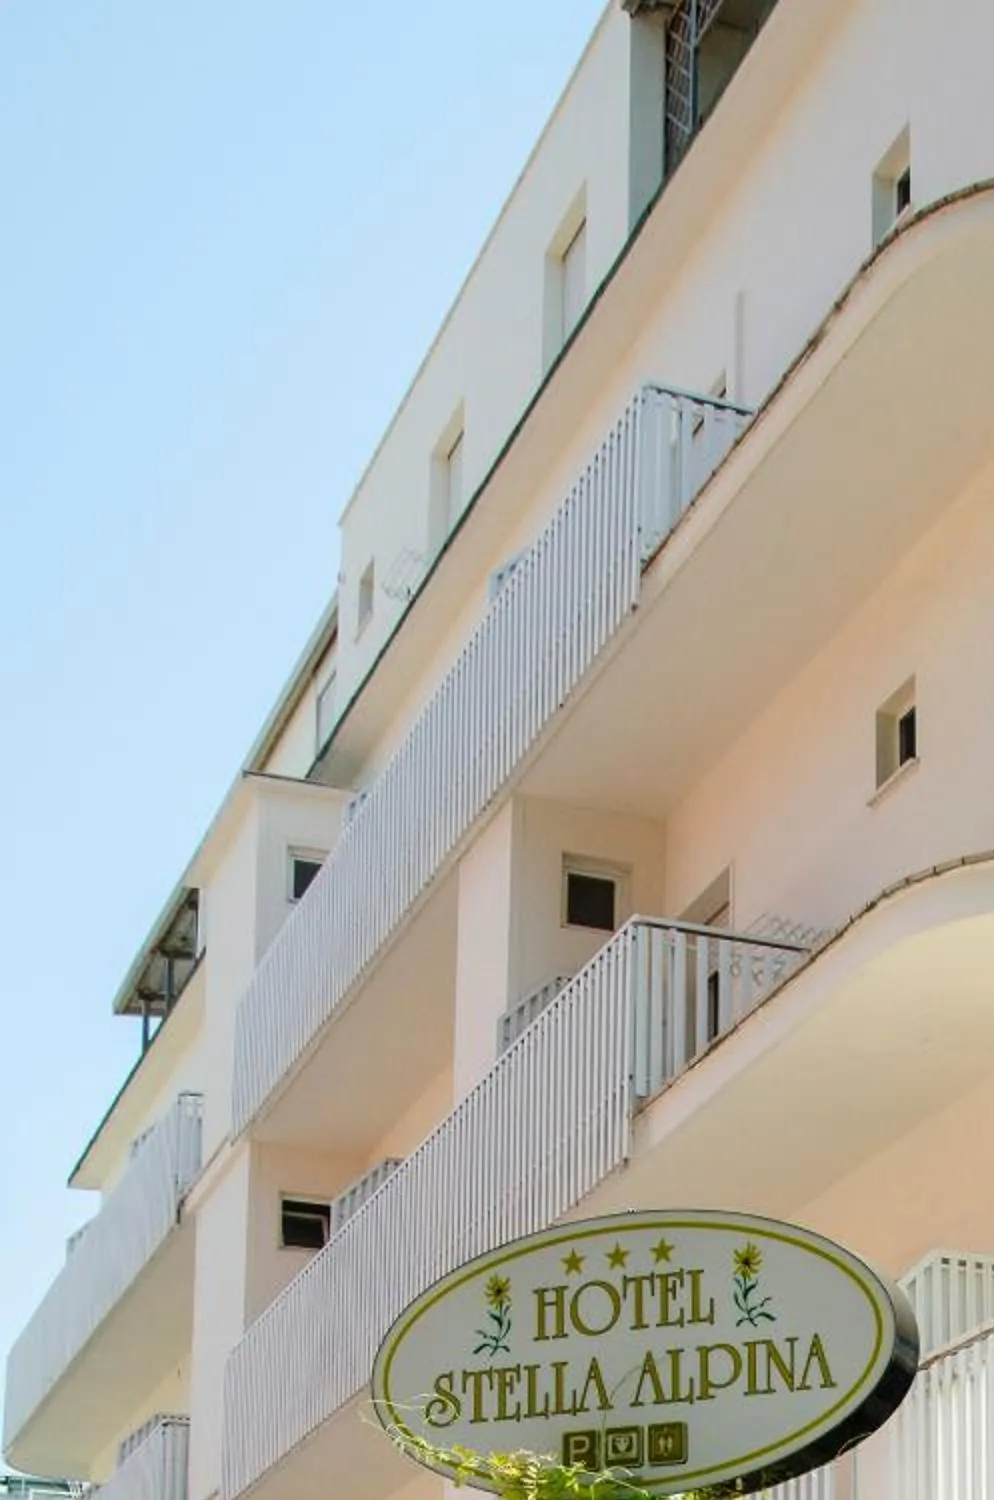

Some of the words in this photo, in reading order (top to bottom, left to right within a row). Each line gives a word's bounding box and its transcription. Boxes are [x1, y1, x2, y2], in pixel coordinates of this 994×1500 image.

[532, 1268, 716, 1342] HOTEL
[424, 1356, 614, 1428] STELLA
[629, 1333, 838, 1407] ALPINA
